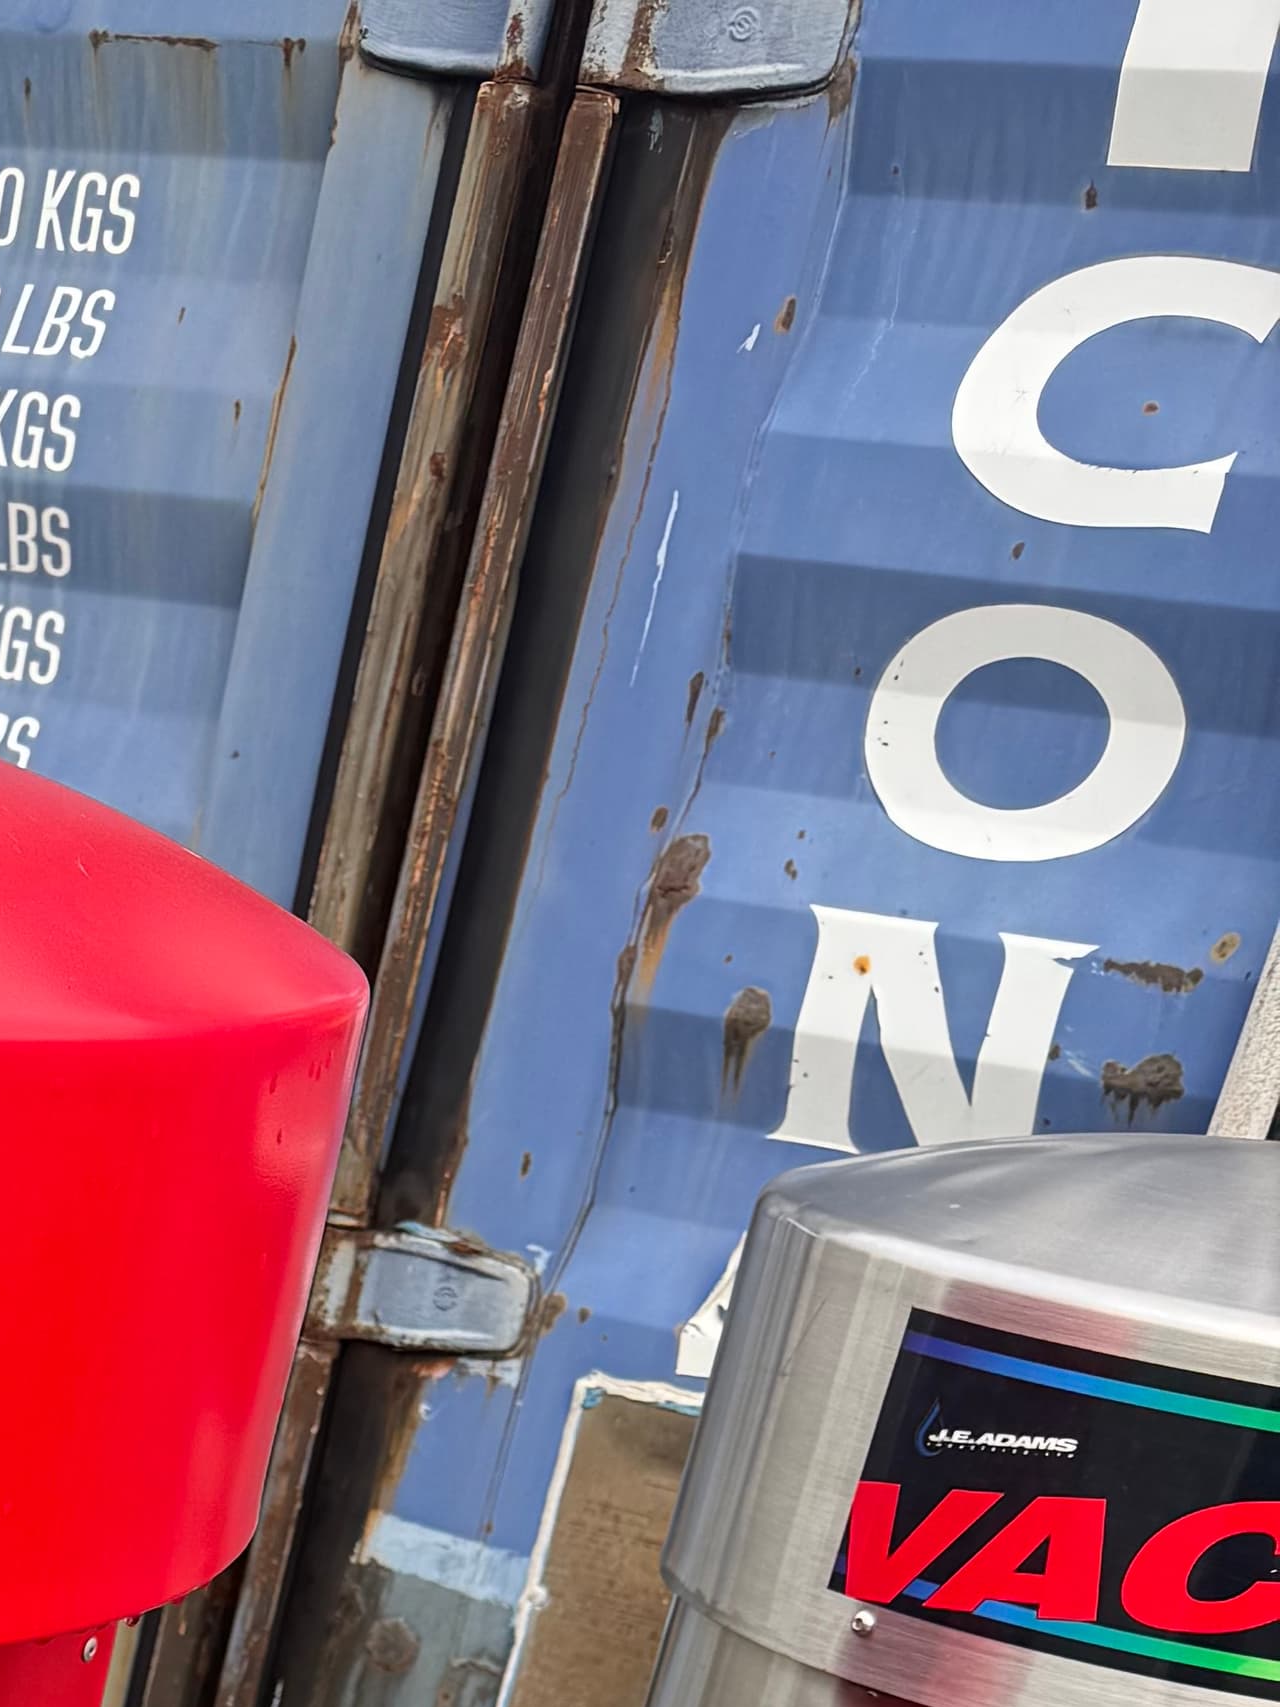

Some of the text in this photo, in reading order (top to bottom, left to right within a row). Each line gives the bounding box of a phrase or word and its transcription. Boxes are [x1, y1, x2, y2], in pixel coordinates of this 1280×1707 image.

[34, 167, 141, 255] KGS
[1, 282, 117, 360] LBS
[845, 1481, 1280, 1635] VAC
